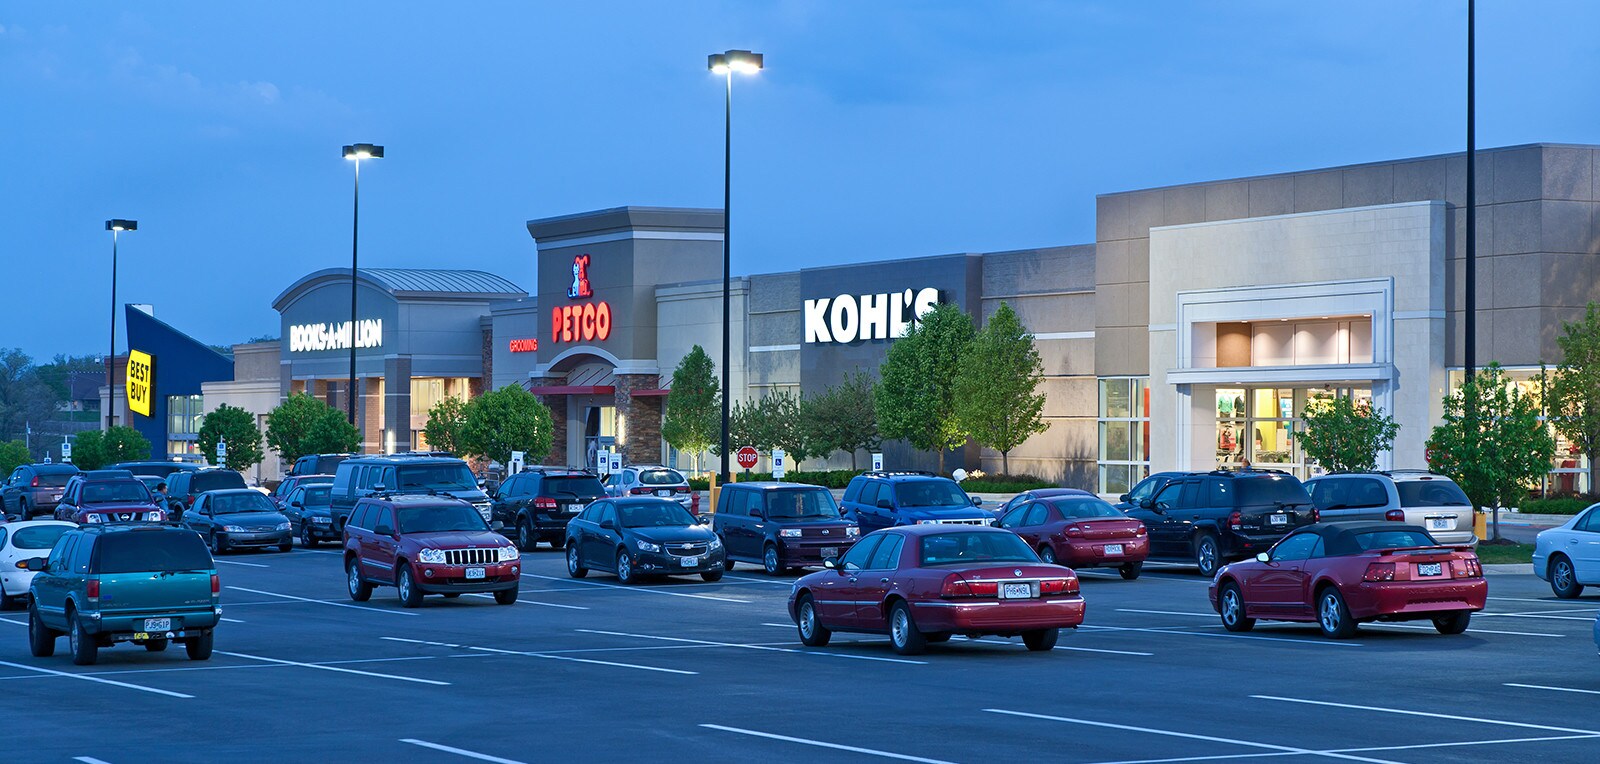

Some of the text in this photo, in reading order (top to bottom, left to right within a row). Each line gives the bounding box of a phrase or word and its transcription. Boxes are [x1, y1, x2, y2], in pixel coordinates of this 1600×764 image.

[552, 301, 611, 343] PETCO
[804, 287, 939, 343] KOHL'S
[509, 338, 538, 352] GROOMING
[130, 359, 149, 382] BEST
[130, 381, 147, 403] BUY
[738, 453, 757, 462] STOP
